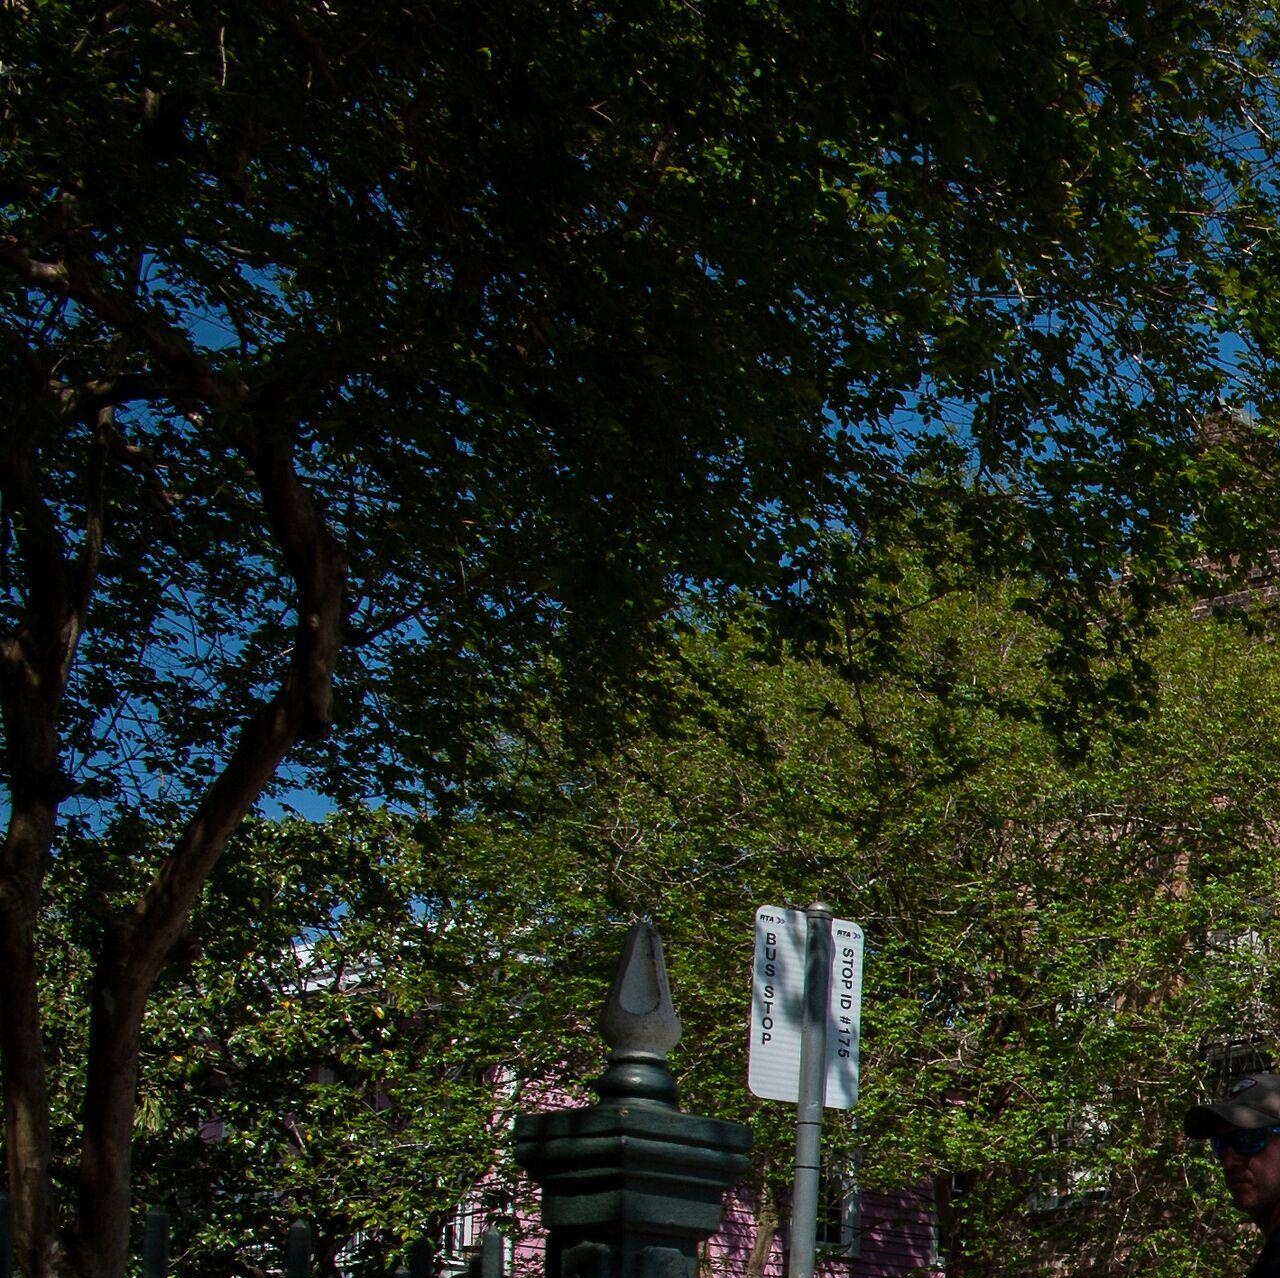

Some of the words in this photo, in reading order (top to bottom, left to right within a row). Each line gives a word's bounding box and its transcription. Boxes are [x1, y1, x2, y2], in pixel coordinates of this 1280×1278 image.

[759, 914, 775, 923] RTA
[836, 929, 851, 939] RTA
[765, 933, 777, 977] BUS
[841, 948, 854, 990] STOP
[762, 986, 774, 1045] STOP
[840, 994, 853, 1010] ID
[838, 1016, 851, 1059] #175
